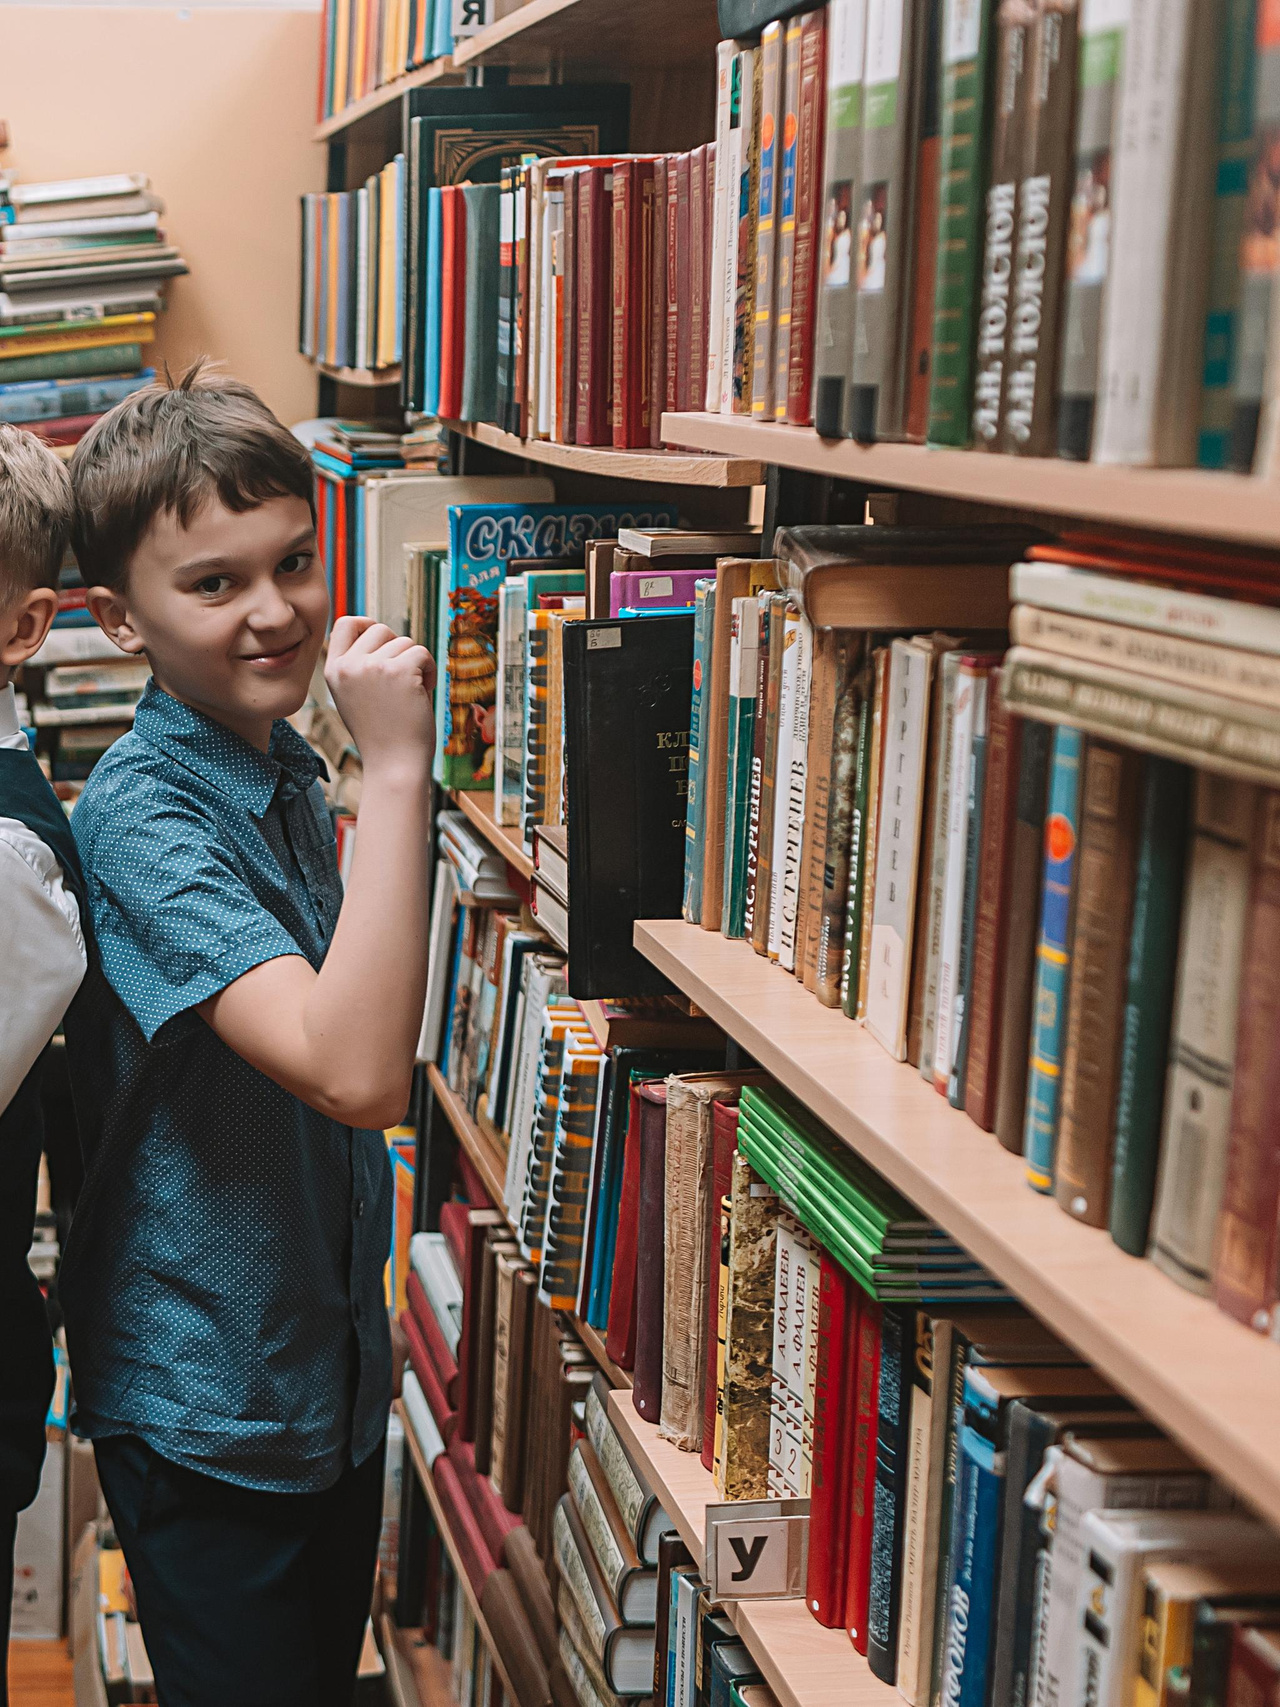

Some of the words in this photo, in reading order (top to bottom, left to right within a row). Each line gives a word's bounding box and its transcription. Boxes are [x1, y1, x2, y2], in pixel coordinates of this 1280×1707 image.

[460, 0, 486, 26] Я
[469, 566, 501, 590] для
[888, 654, 910, 903] ТУРГЕНЕВ
[747, 757, 761, 878] ТУРГЕНЕВ
[783, 760, 804, 896] ТУРГЕНЕВ
[744, 884, 756, 933] И.С.
[777, 1247, 790, 1334] ФАДЕЕВ
[792, 1264, 806, 1352] ФАДЕЕВ
[809, 1285, 819, 1373] ФАДЕЕВ
[774, 1428, 783, 1456] 3
[787, 1447, 798, 1476] 2
[805, 1472, 810, 1496] 1
[727, 1535, 769, 1582] У
[909, 1529, 917, 1577] СМЕРТЬ
